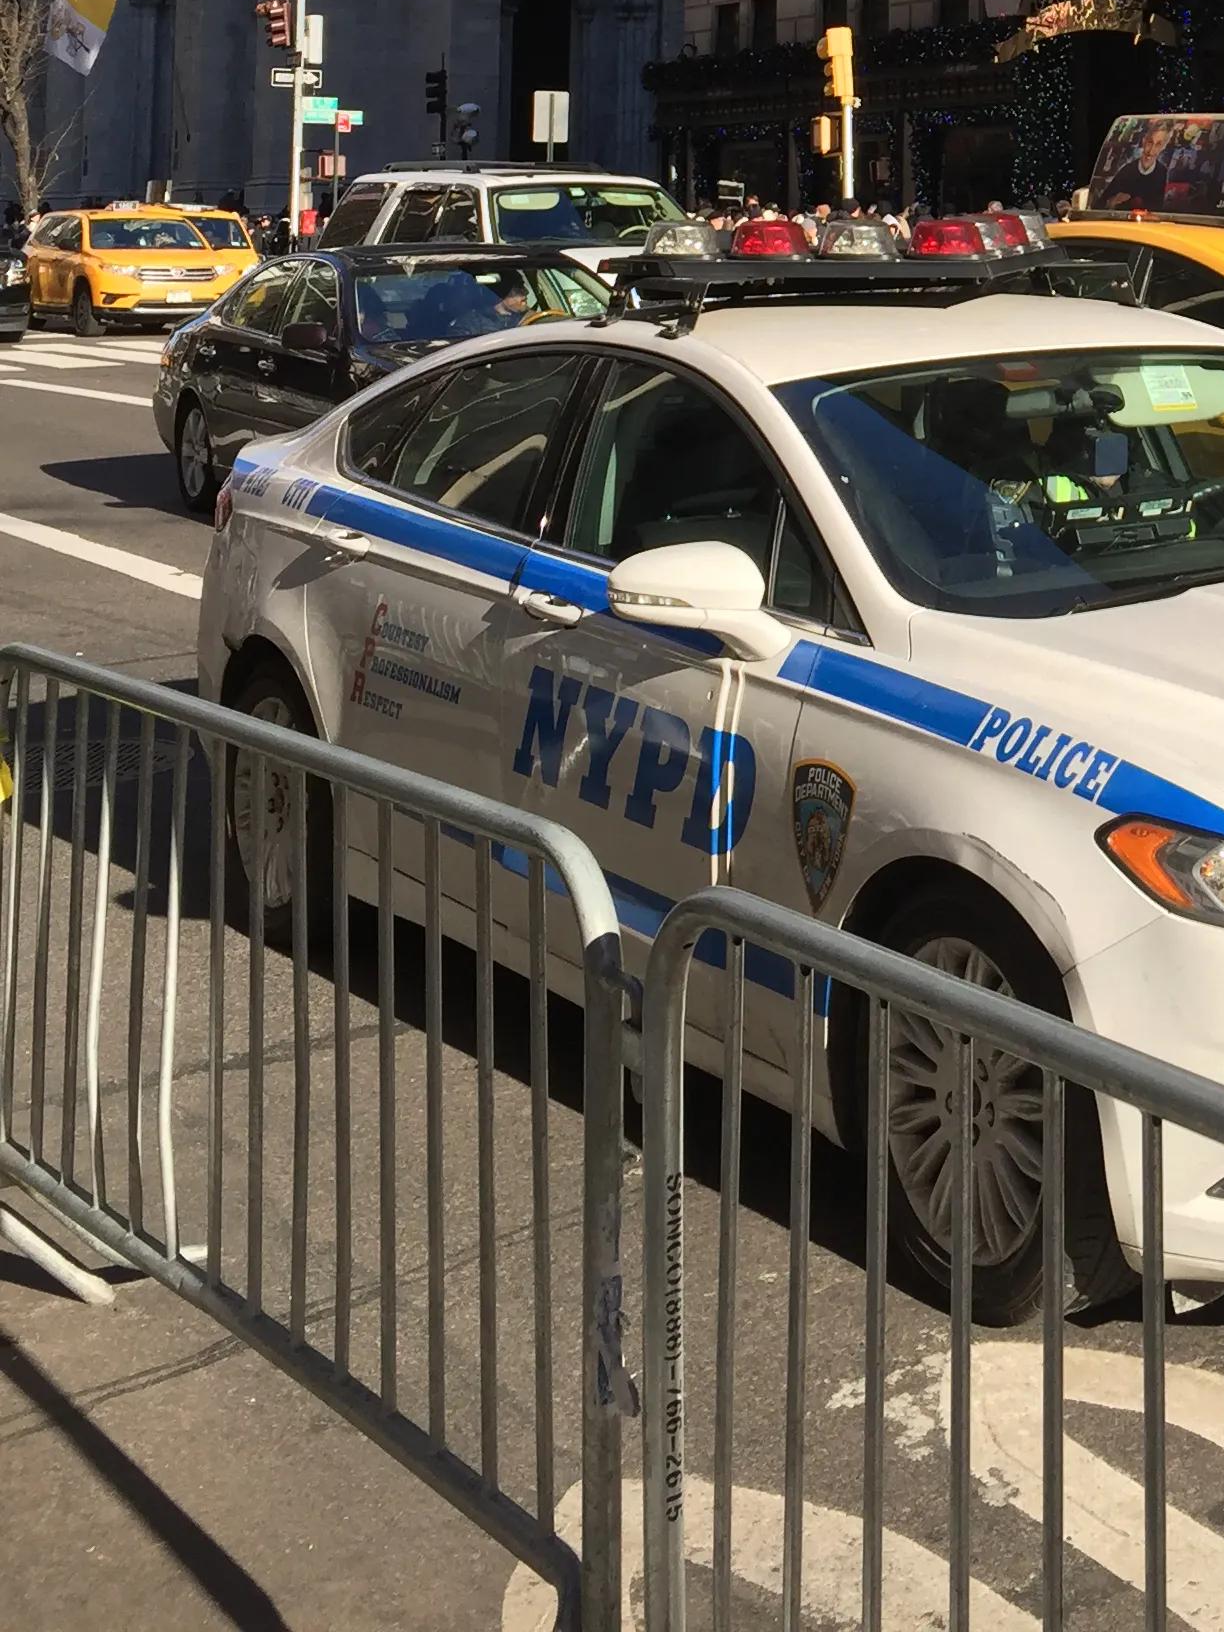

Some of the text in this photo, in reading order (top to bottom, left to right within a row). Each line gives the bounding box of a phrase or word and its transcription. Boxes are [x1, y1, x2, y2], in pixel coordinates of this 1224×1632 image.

[371, 602, 430, 653] COURTESY
[350, 670, 403, 720] RESPECT
[360, 636, 462, 704] PROFESSIONALISM
[513, 665, 756, 855] NYPD
[807, 767, 843, 794] POLICE
[969, 706, 1118, 802] POLICE
[795, 784, 849, 822] DEPARTMENT
[665, 1172, 682, 1286] SONCO
